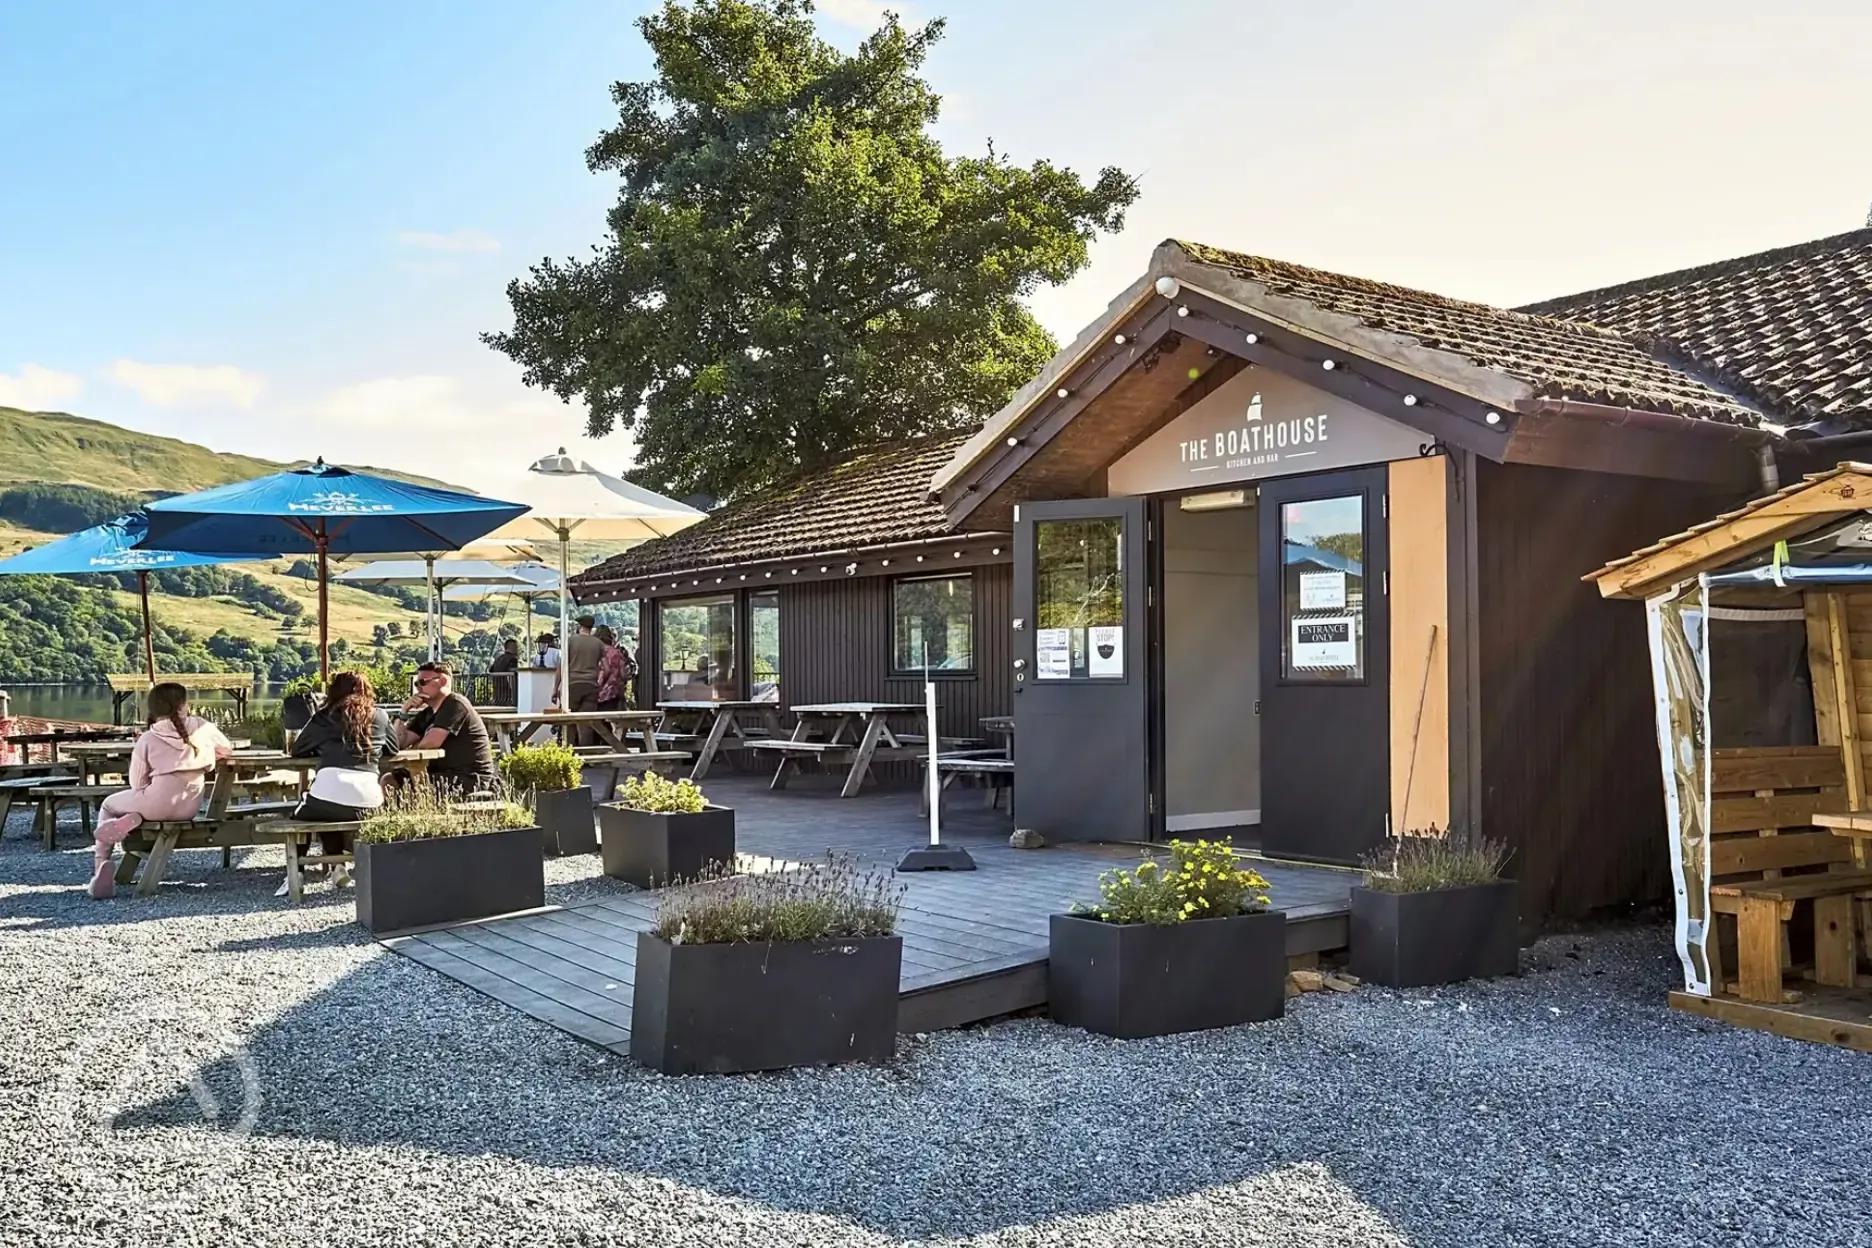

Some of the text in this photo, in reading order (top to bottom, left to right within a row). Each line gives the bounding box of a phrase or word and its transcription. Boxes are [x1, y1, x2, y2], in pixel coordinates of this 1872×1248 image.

[1180, 414, 1328, 463] THE BOATHOUSE
[1226, 453, 1279, 469] KITCHEN AND BAR
[287, 502, 395, 512] HEVERLEE
[89, 555, 175, 566] HEVERLEE
[1301, 624, 1346, 635] ENTRANCE
[1311, 633, 1333, 642] ONLY
